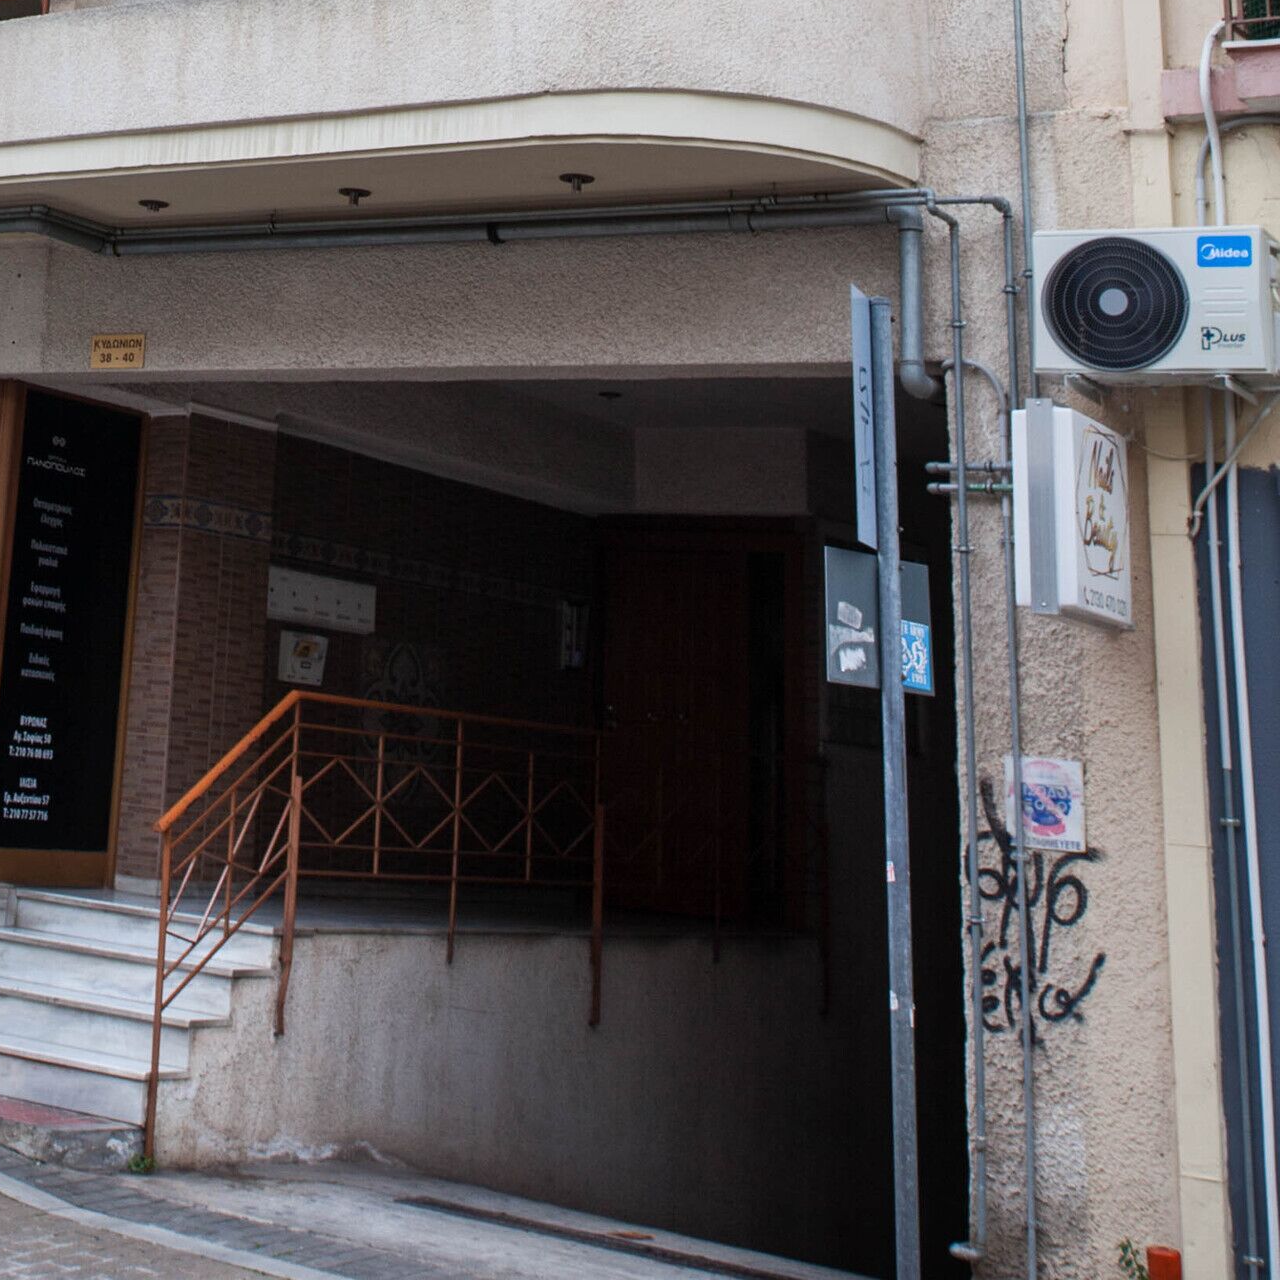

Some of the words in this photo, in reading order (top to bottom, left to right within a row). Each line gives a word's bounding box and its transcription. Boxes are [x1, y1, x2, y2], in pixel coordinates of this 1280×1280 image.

[1204, 246, 1250, 260] Midea
[93, 339, 143, 352] ΚΥΔΩΝΙΩΝ
[99, 352, 112, 363] 38
[122, 352, 135, 363] 40
[1088, 440, 1115, 496] Nails
[1083, 495, 1118, 573] Beauty
[15, 746, 27, 757] 210
[9, 808, 21, 819] 210
